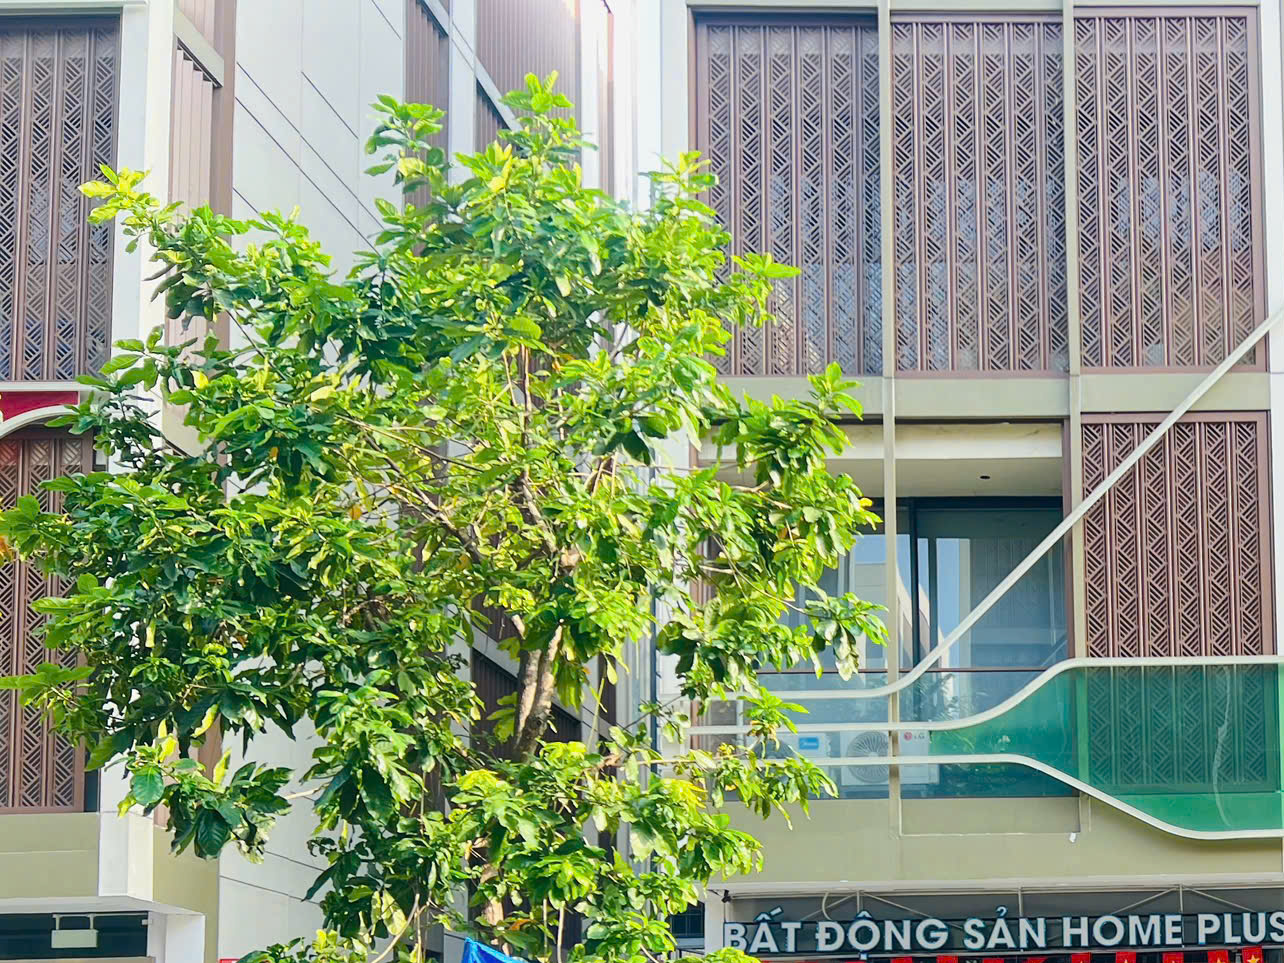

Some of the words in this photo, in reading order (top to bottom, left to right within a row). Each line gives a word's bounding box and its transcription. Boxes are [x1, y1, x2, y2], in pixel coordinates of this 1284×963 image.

[725, 907, 801, 953] BẤT
[816, 911, 949, 960] ĐỘNG
[963, 906, 1046, 950] SẢN
[1062, 914, 1182, 947] HOME
